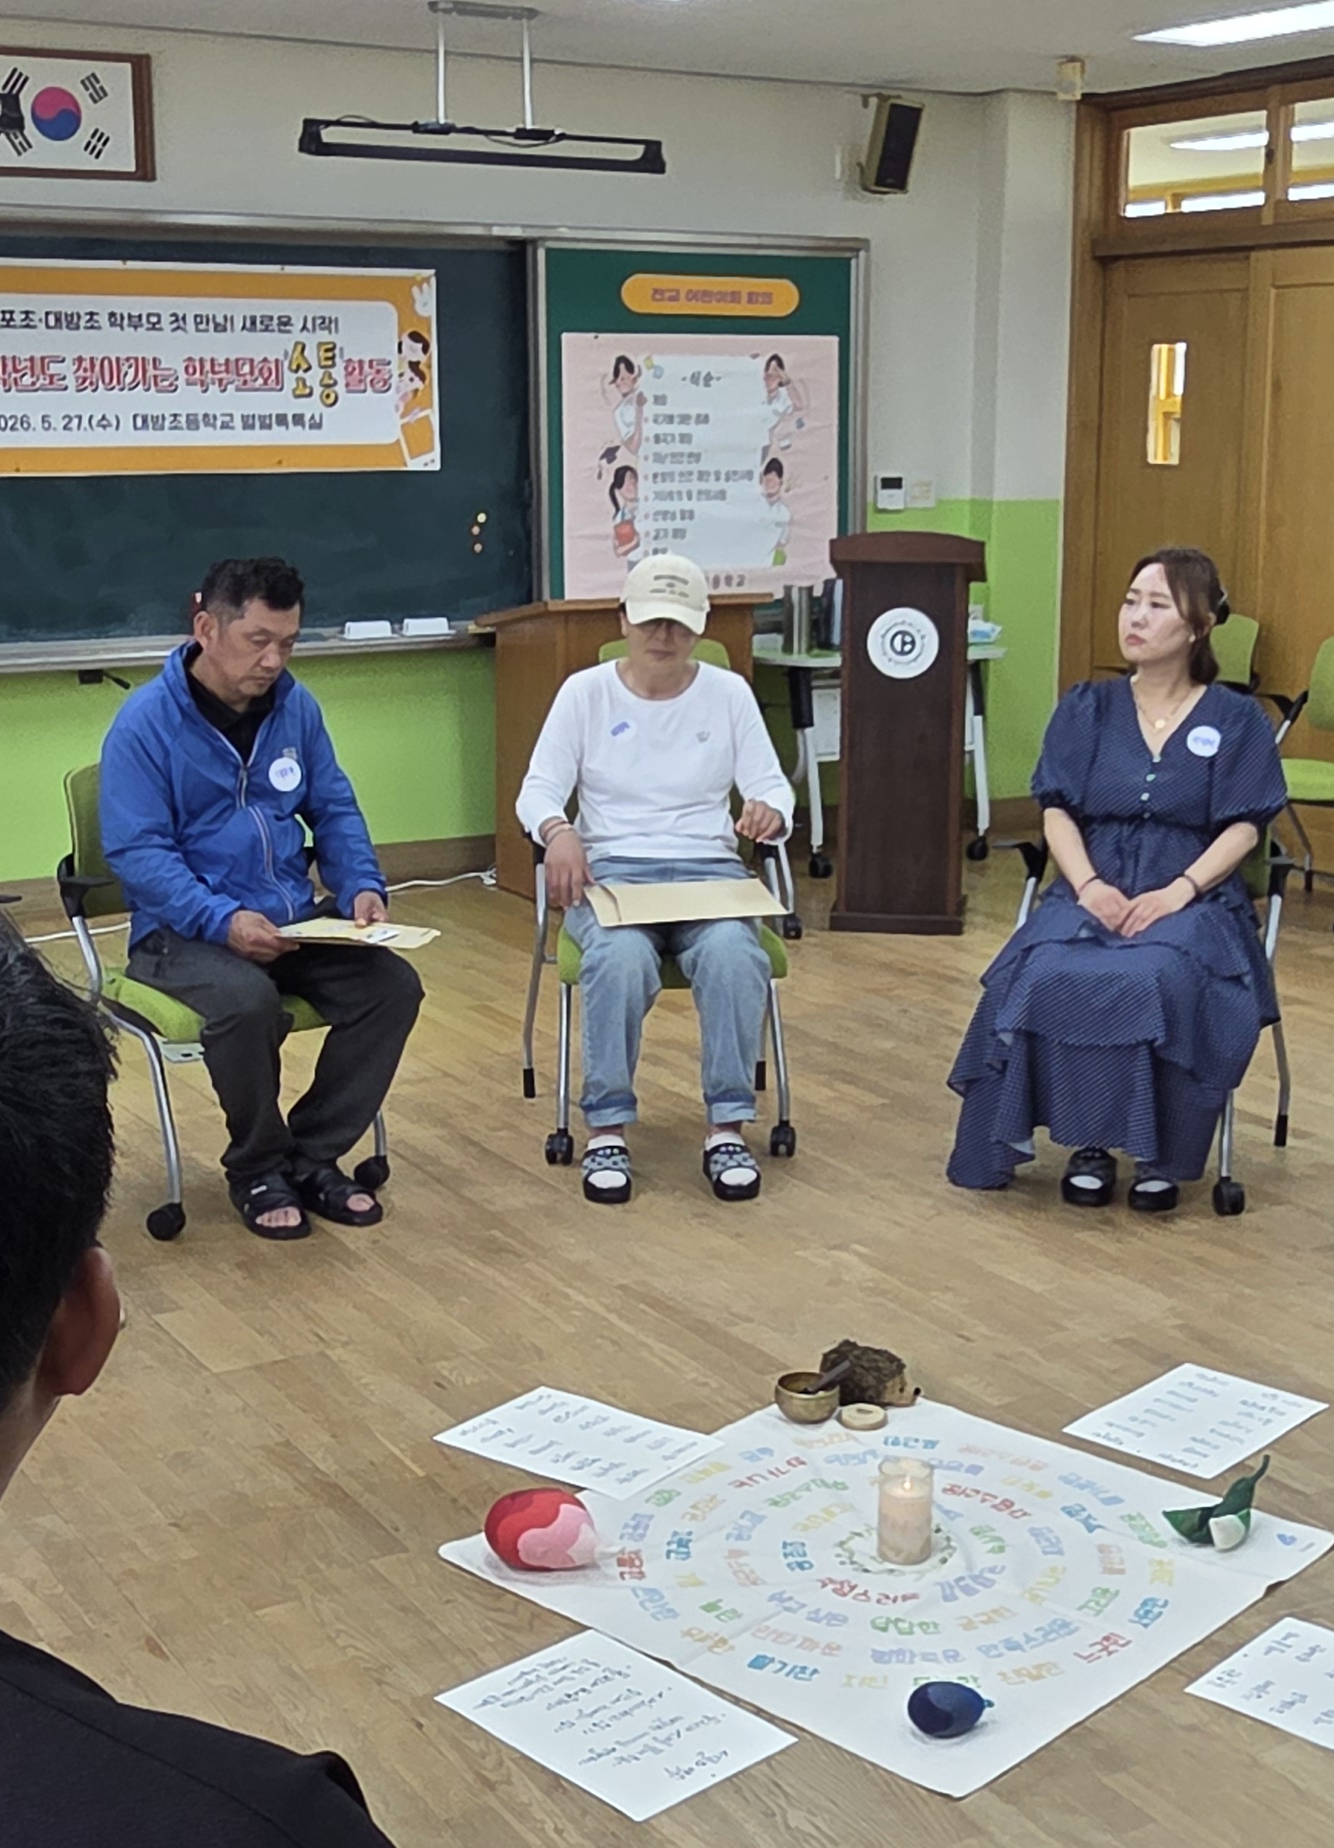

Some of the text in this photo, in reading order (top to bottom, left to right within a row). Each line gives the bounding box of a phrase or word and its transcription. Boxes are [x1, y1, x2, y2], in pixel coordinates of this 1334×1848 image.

[108, 312, 165, 332] 학부모
[169, 313, 188, 334] 첫
[241, 315, 295, 335] 새로운
[73, 356, 180, 394] 찾아가는
[183, 357, 284, 394] 학부모회
[343, 357, 394, 395] 활동
[41, 416, 59, 433] 5.
[746, 1654, 820, 1683] 활기찬
